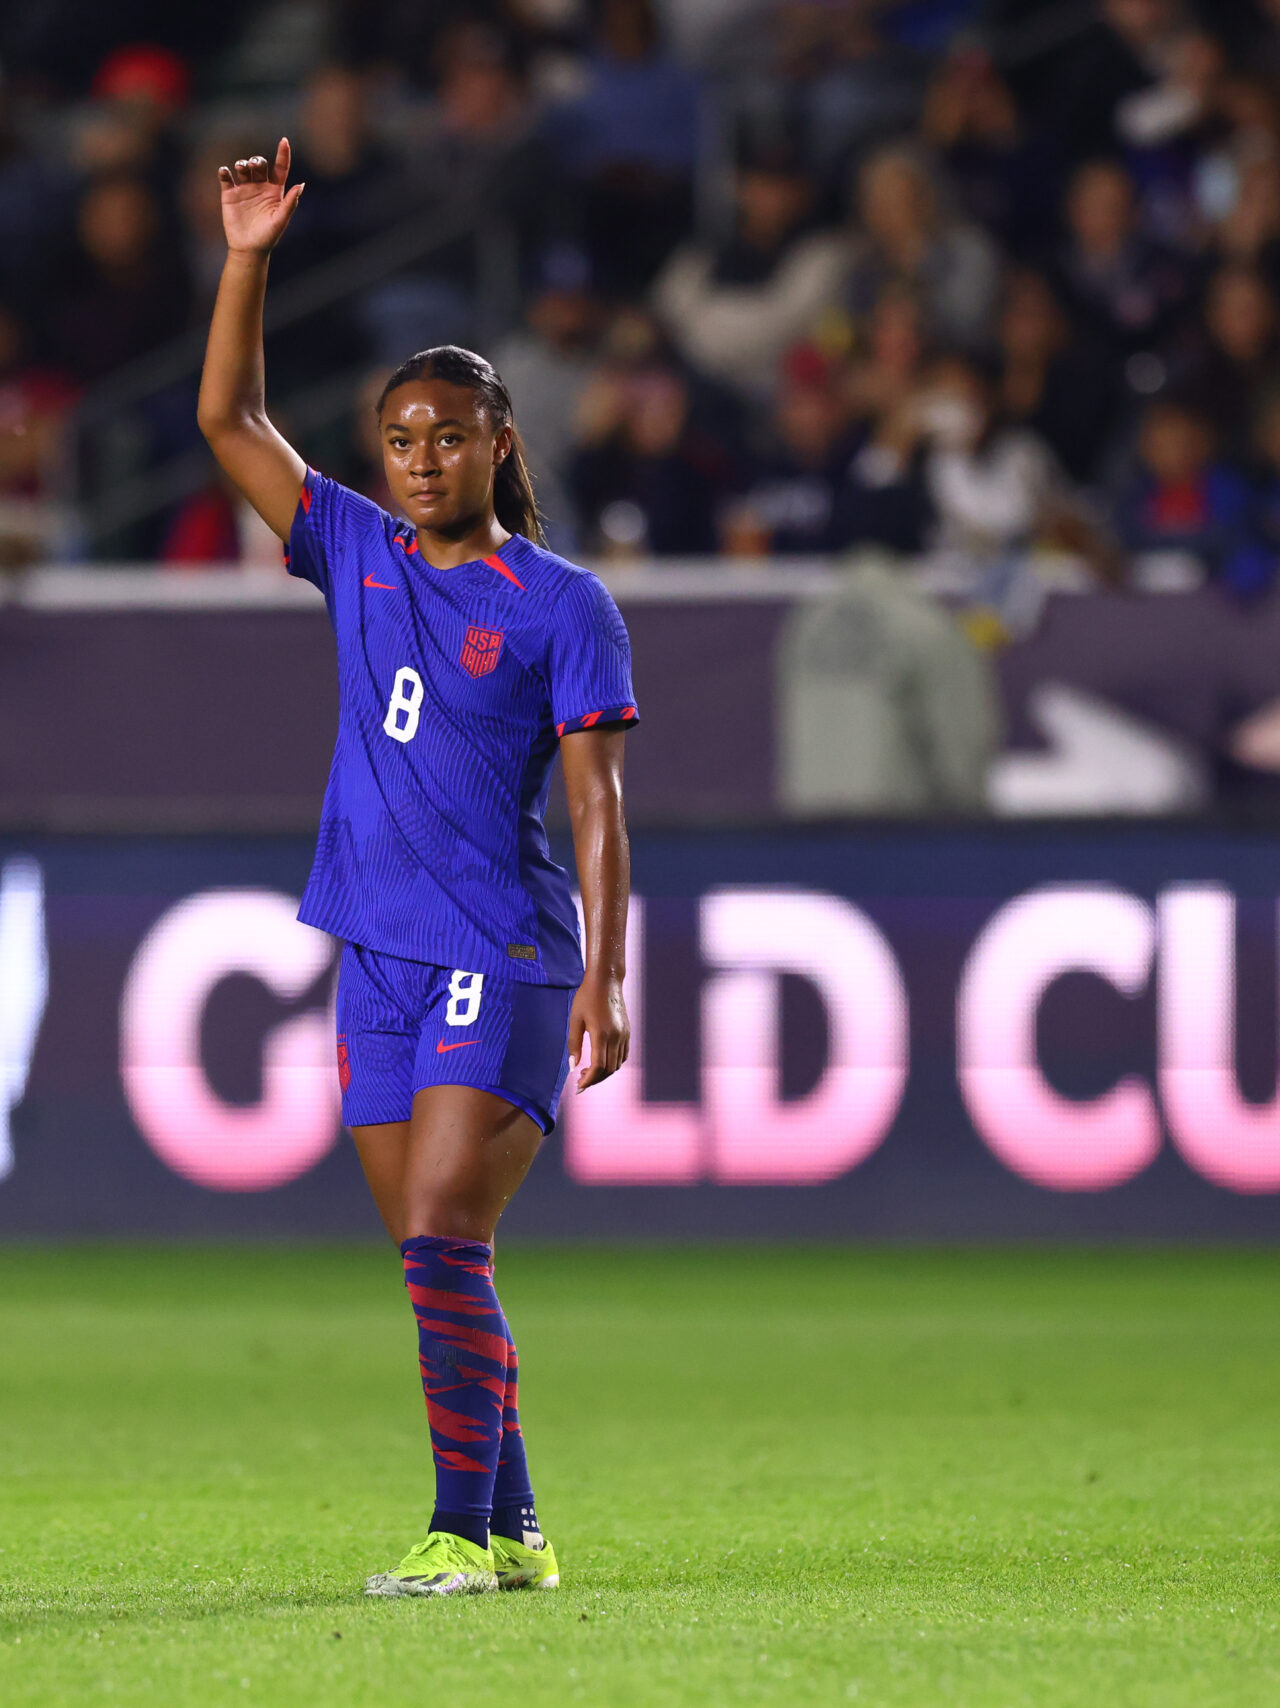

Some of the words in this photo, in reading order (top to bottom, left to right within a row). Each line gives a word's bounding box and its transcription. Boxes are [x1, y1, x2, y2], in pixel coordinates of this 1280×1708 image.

[468, 629, 500, 651] USA
[382, 666, 424, 743] 8
[445, 969, 484, 1026] 8
[121, 886, 910, 1191] GLD
